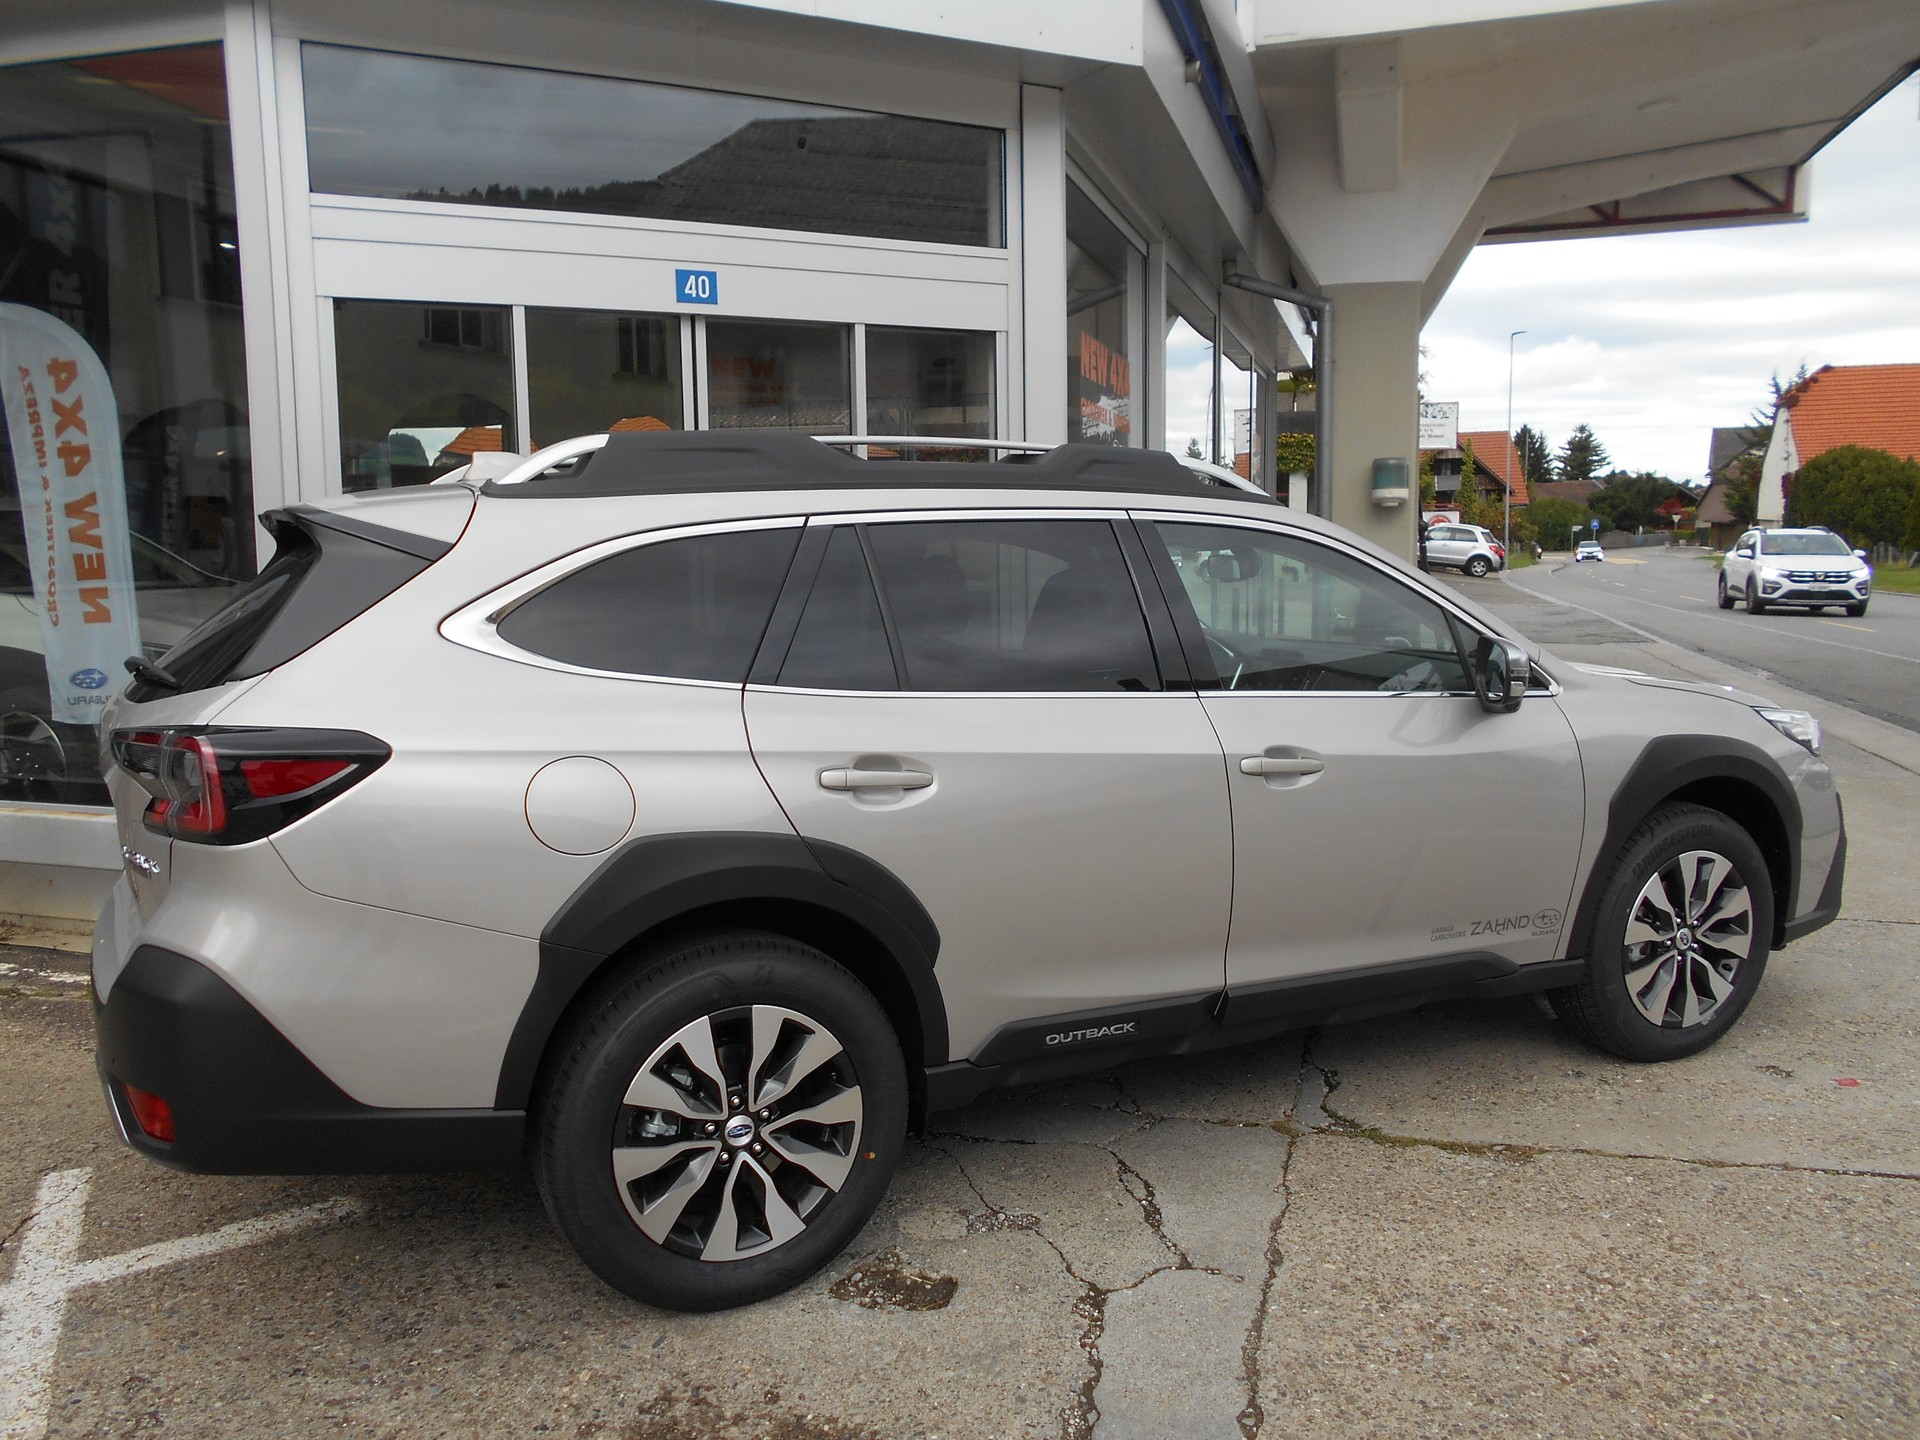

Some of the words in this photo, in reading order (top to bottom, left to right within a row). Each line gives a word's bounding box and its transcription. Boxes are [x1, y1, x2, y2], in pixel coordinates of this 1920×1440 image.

[684, 275, 710, 298] 40
[711, 355, 776, 378] NEW
[1081, 331, 1109, 388] NEW
[1470, 915, 1530, 936] ZAHND
[1532, 929, 1559, 937] SUBARU
[1045, 1022, 1135, 1045] OUTBACK
